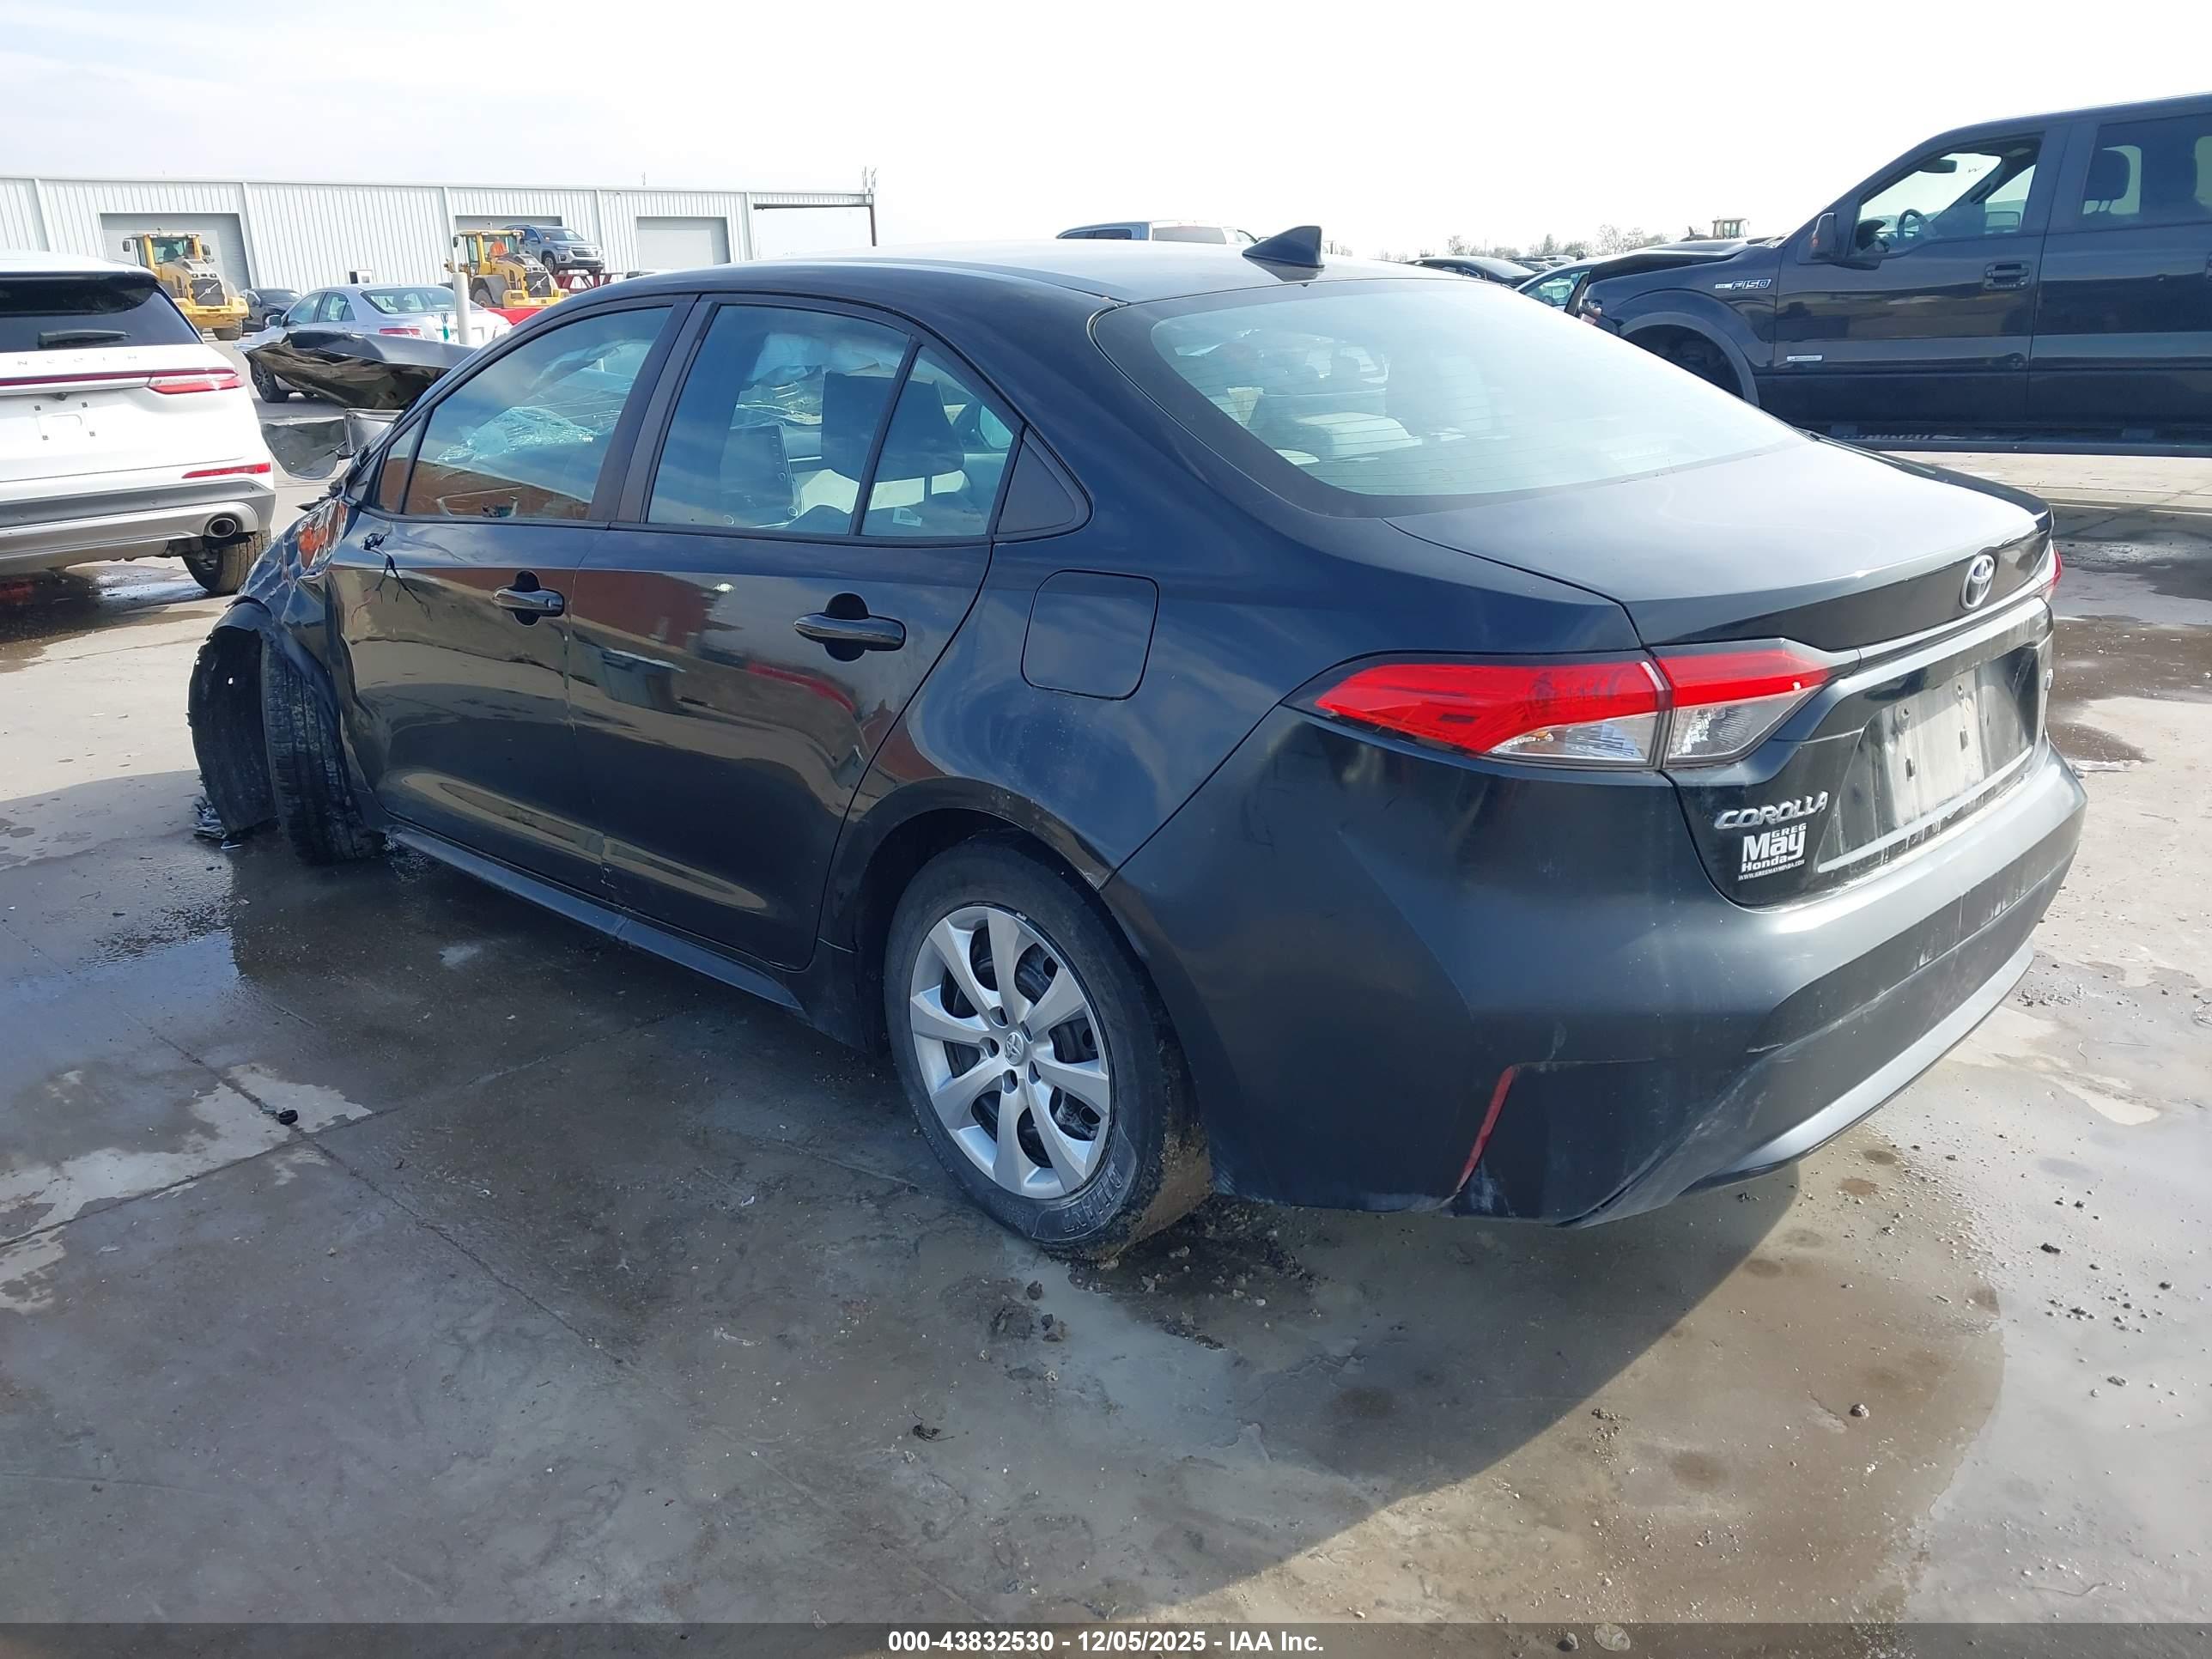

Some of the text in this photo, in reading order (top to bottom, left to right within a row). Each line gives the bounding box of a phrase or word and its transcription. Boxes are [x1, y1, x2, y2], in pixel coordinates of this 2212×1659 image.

[1715, 791, 1829, 829] COROLLA
[1771, 822, 1808, 838] GREG
[1742, 830, 1806, 863] May
[1741, 854, 1788, 873] Honda
